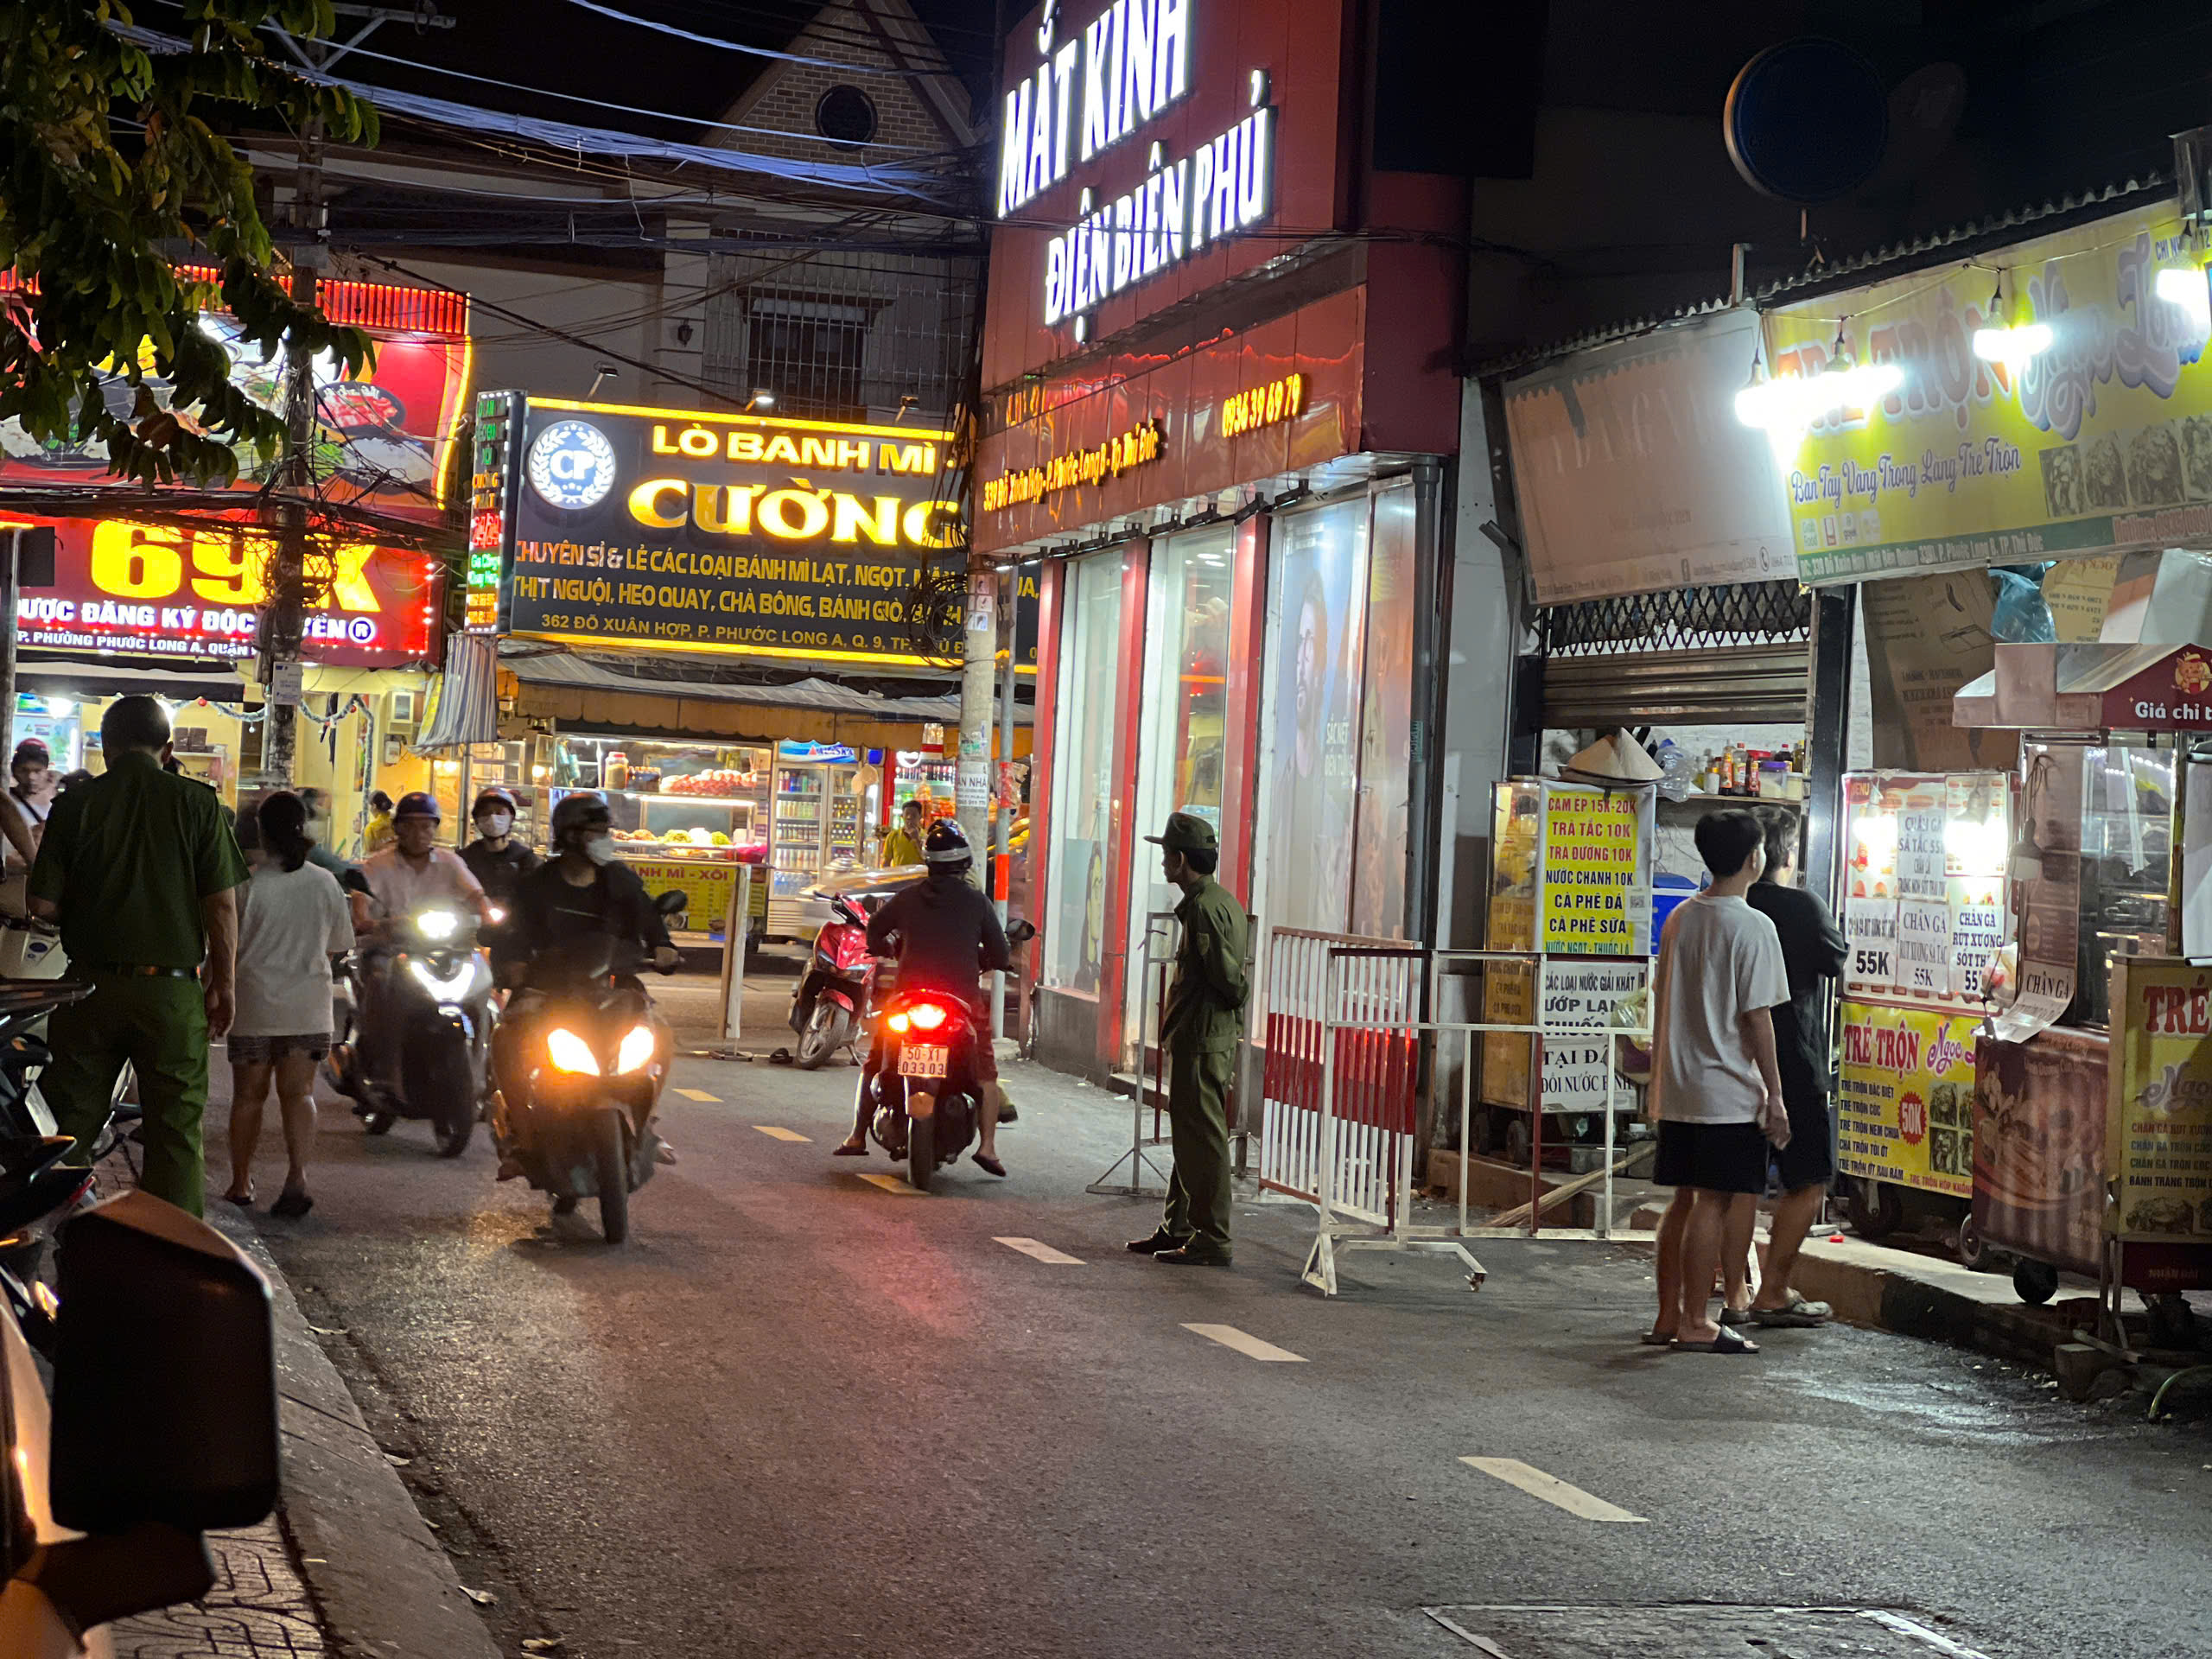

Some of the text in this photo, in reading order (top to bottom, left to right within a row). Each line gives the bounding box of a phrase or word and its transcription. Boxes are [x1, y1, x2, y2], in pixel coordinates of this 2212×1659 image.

[1045, 70, 1268, 343] ĐIỆN BIÊN PHỦ
[1222, 372, 1300, 437] 0936 39 69 79
[652, 423, 719, 457] LÒ
[879, 442, 937, 474] MÌ
[550, 450, 594, 479] CP
[1819, 466, 1842, 508] Tay
[1878, 454, 1916, 498] Trong
[1984, 436, 2021, 478] Trộn
[628, 477, 966, 550] CƯỜNG
[607, 547, 624, 569] &
[626, 543, 647, 571] LẺ
[650, 547, 688, 574] CÁC
[690, 553, 733, 580] LOẠI
[735, 554, 785, 583] BÁNH
[788, 556, 810, 582] MÌ
[619, 582, 656, 606] HEO
[658, 586, 715, 613] QUAY,
[719, 588, 756, 614] CHÀ
[760, 589, 817, 618] BÔNG,
[819, 593, 869, 620] BÁNH
[81, 600, 156, 628] ĐĂNG
[161, 607, 198, 632] KÝ
[201, 608, 256, 633] ĐỘC
[34, 631, 93, 647] PHƯỜNG
[97, 635, 146, 650] PHƯỚC
[149, 639, 188, 652] LONG
[542, 613, 569, 628] 362
[573, 613, 598, 630] ĐỖ
[602, 617, 649, 633] XUÂN
[698, 625, 710, 638] P.
[715, 625, 777, 643] PHƯỚC
[782, 631, 828, 645] LONG
[852, 634, 868, 649] Q.
[2135, 702, 2200, 720] Giá chỉ
[1548, 797, 1571, 812] CAM
[1553, 820, 1575, 836] TRÀ
[1607, 824, 1631, 838] 10K
[1613, 848, 1632, 862] 10K
[666, 867, 684, 879] MÌ
[699, 869, 728, 880] XÔI
[1546, 868, 1633, 886] NƯỚC CHANH 10K
[1554, 892, 1623, 910] CÀ PHÊ ĐÁ
[1549, 915, 1626, 934] CÀ PHÊ SỮA
[1903, 909, 1930, 933] CHÂN
[1933, 911, 1947, 934] GÀ
[1959, 909, 1997, 927] CHÂN GÀ
[1953, 929, 2003, 948] RÚT XƯƠNG
[1856, 950, 1890, 976] 55K
[1956, 948, 1974, 967] SỐT
[1546, 969, 1635, 994] CÁC LOẠI NƯỚC GIẢI KHÁT
[1914, 968, 1933, 986] 55K
[1965, 969, 1981, 991] 55
[2026, 970, 2069, 1000] CHÂN GÀ
[1545, 995, 1580, 1012] ƯỚP
[2143, 974, 2210, 1034] TRÉ
[1844, 1016, 1872, 1062] TRÉ
[1876, 1020, 1920, 1079] TRỘN
[1543, 1050, 1576, 1069] TẠI
[1565, 1071, 1599, 1092] NƯỚC
[1902, 1102, 1923, 1135] 50K
